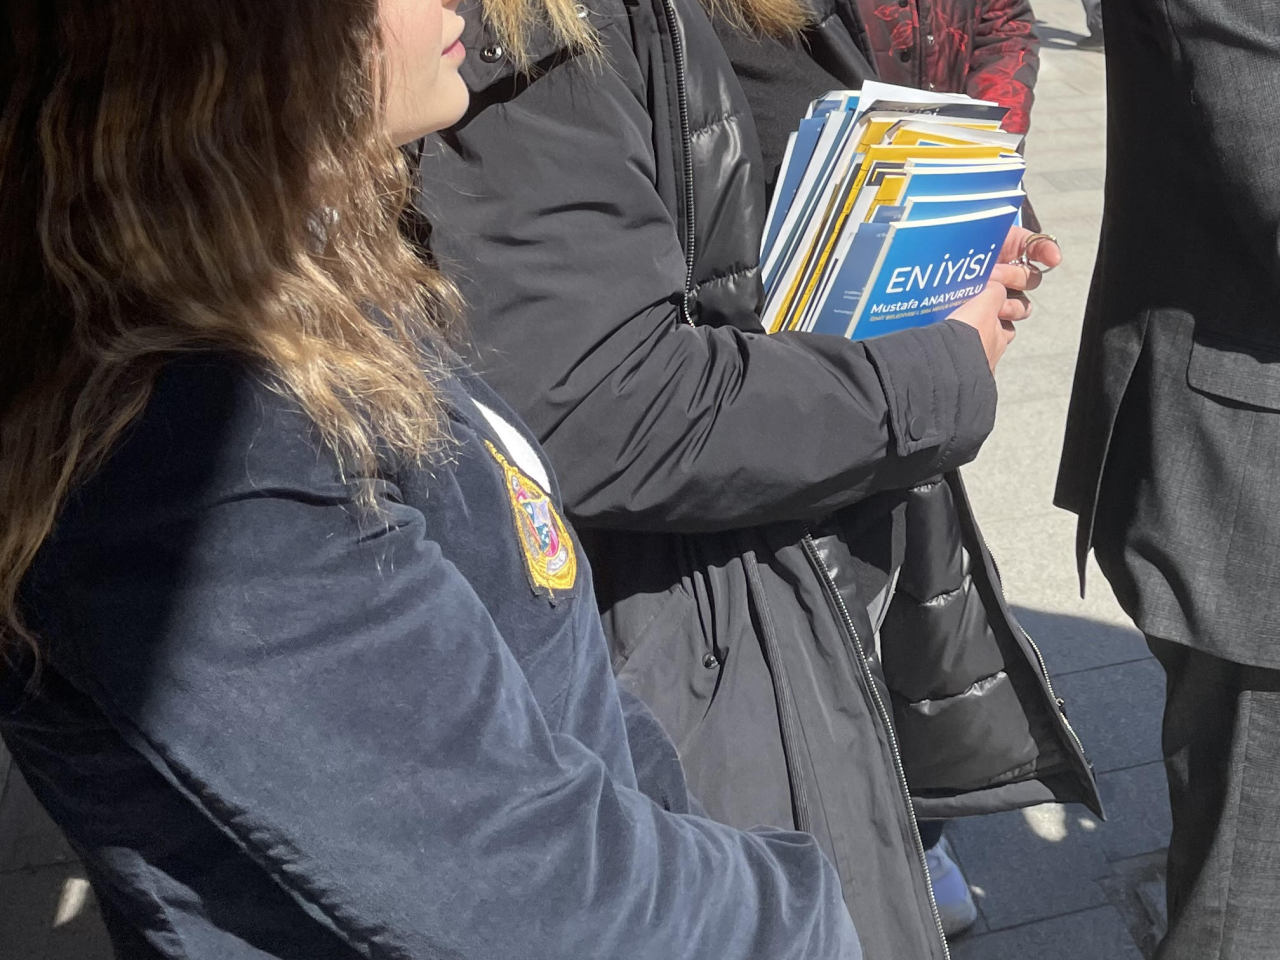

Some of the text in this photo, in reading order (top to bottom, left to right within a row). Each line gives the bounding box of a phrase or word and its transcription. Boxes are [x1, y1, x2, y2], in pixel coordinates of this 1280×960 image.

[885, 243, 996, 294] EN İYİSİ
[870, 283, 983, 314] Mustafa ANAYURTLU
